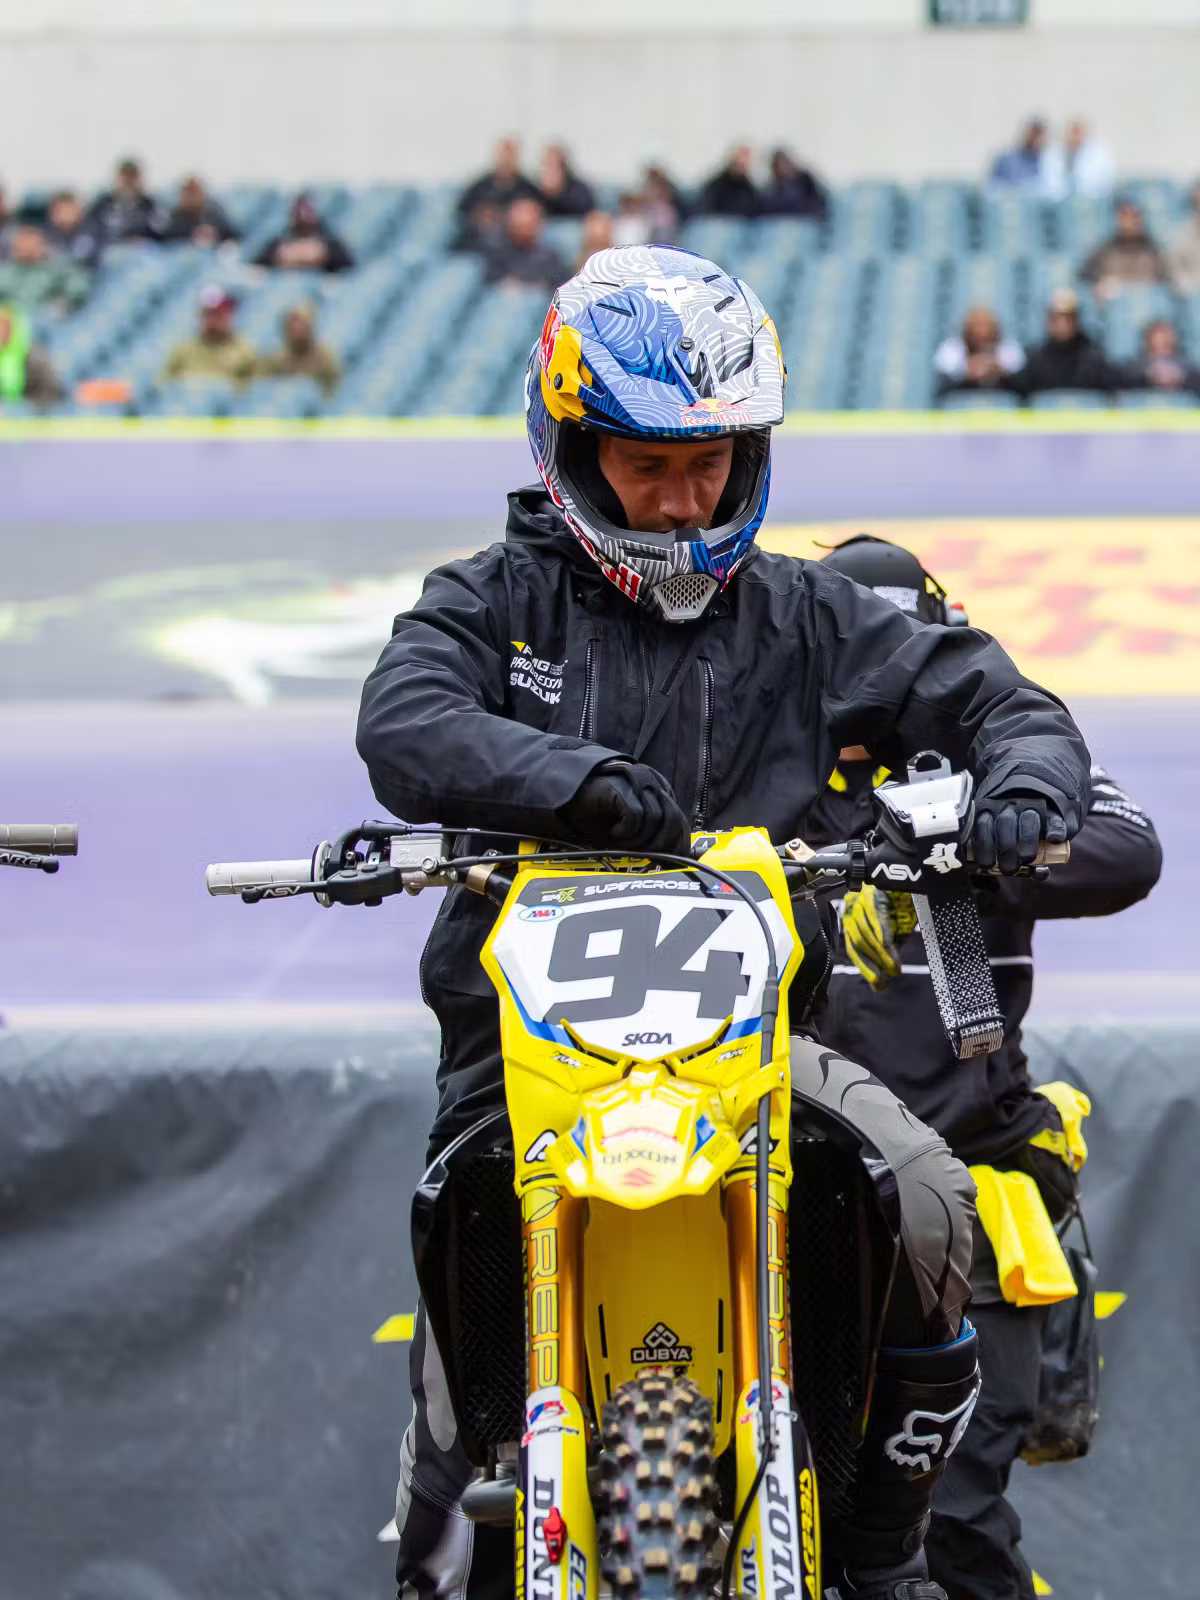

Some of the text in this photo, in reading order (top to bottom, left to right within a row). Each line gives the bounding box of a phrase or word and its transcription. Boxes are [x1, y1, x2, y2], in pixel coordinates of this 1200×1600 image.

[680, 411, 752, 427] Red Bull
[510, 672, 562, 704] SUZUK
[816, 867, 847, 877] ASV
[871, 862, 922, 881] ASV
[262, 885, 301, 898] ASV
[543, 904, 752, 1025] 94
[621, 1031, 673, 1047] SKDA
[632, 1348, 691, 1362] DUBYA
[766, 1473, 795, 1600] NLOP
